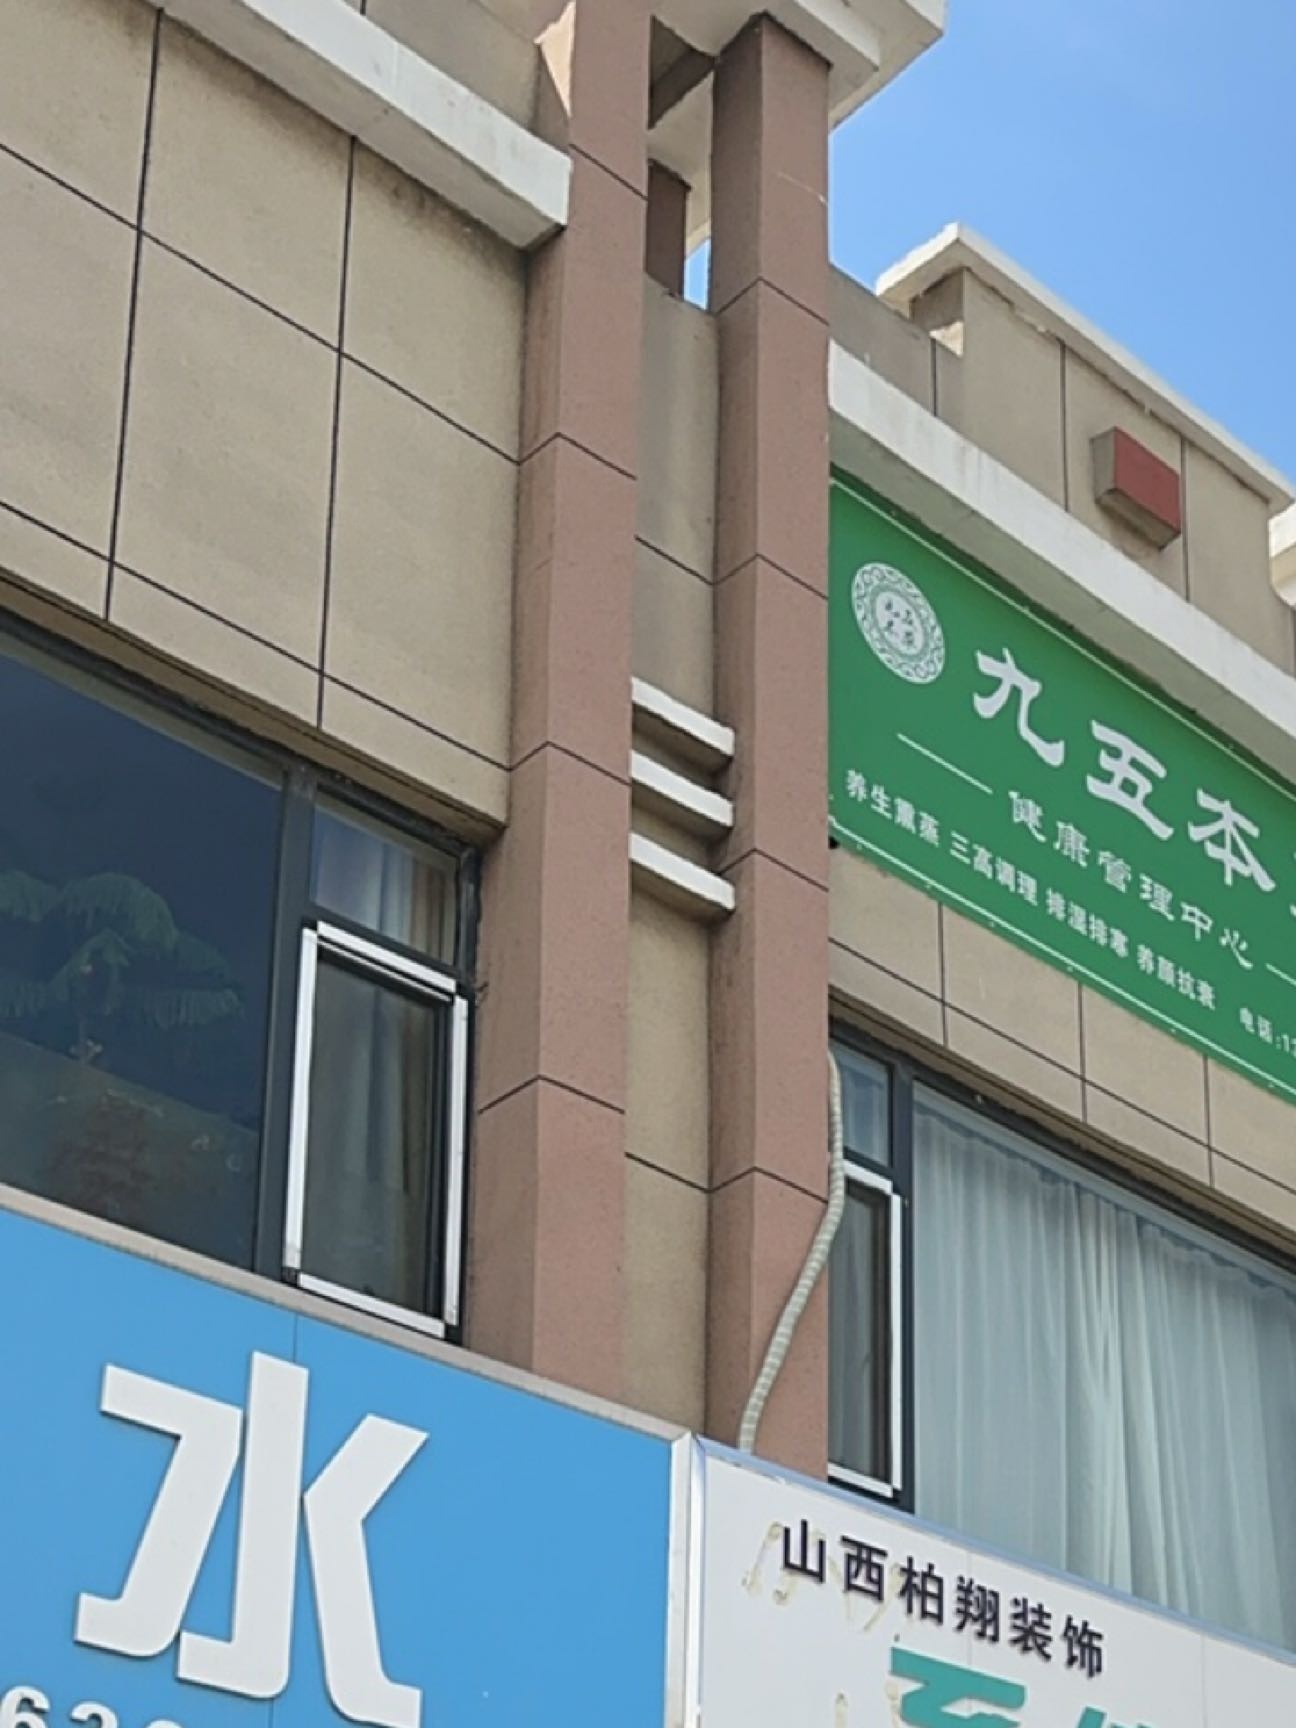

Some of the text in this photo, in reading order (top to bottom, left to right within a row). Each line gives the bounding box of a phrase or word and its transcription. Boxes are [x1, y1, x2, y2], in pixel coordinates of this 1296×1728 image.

[1008, 791, 1253, 968] 健康管理中心
[783, 1519, 1103, 1678] 山西柏翔装饰
